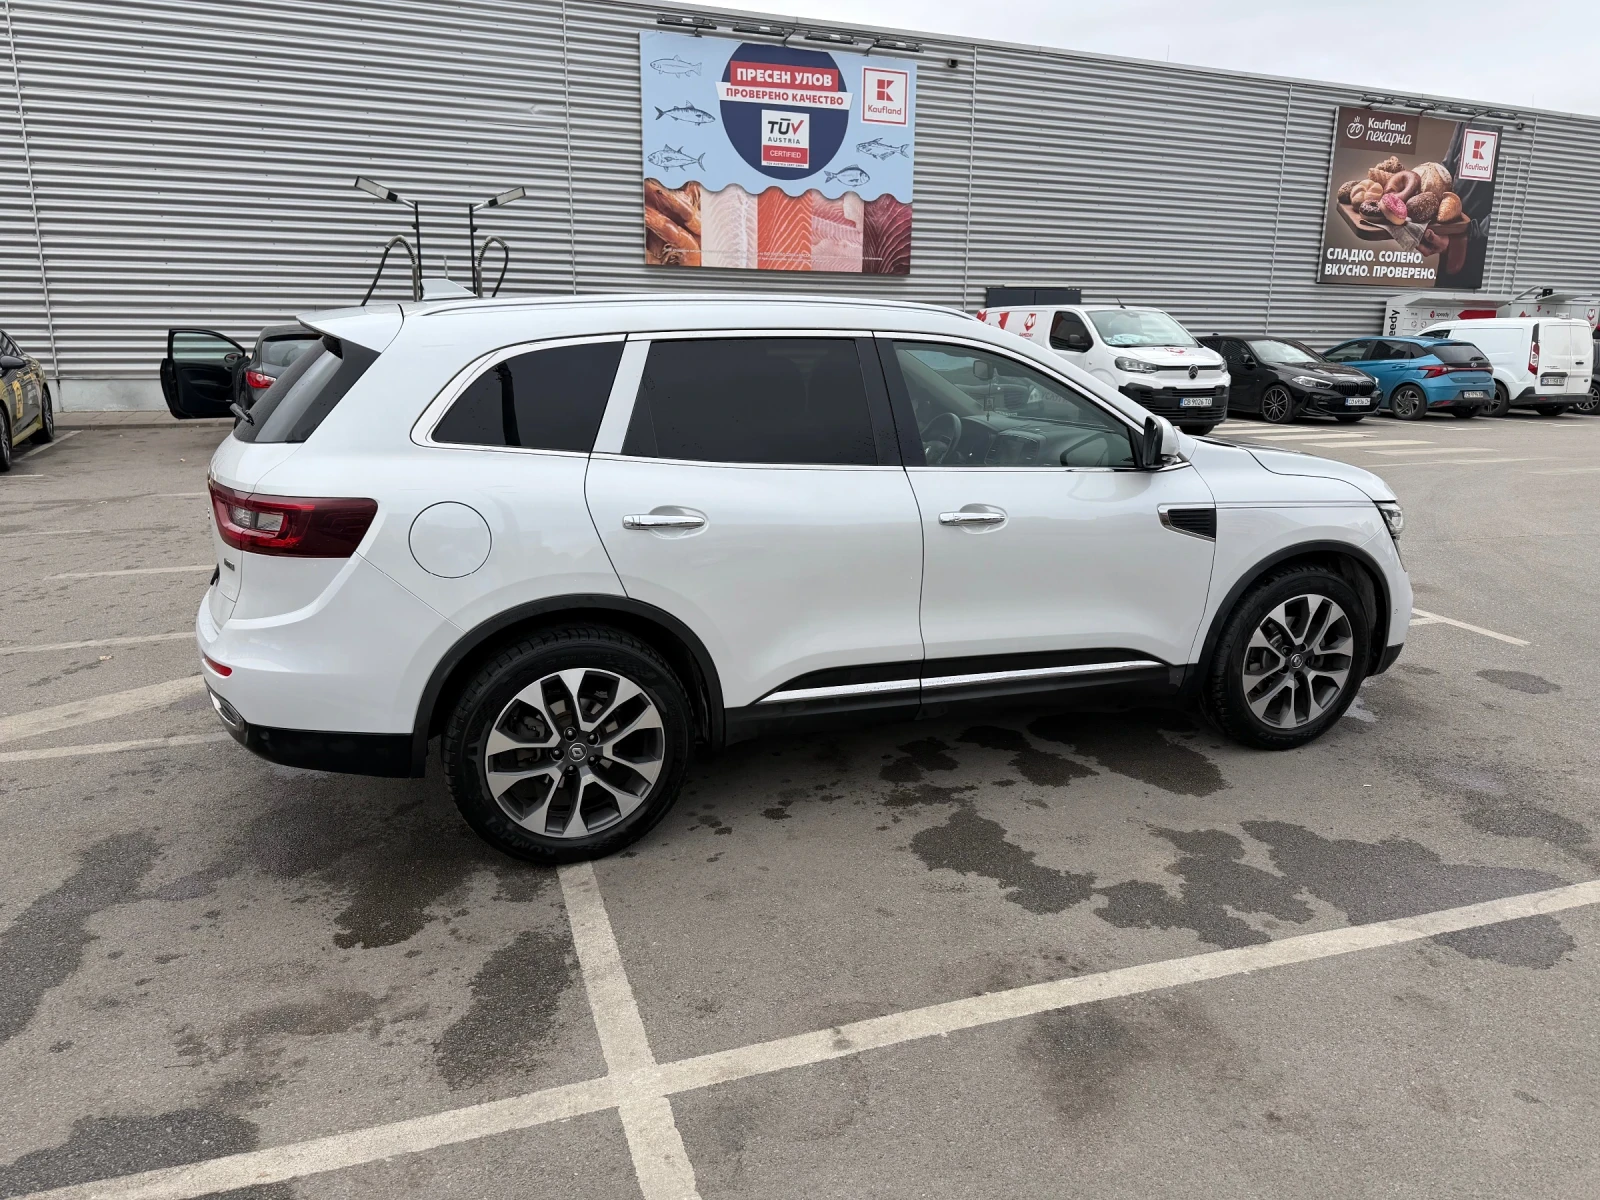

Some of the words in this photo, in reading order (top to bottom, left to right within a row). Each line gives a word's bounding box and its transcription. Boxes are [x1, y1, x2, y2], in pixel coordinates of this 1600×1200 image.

[737, 68, 790, 84] ПРЕСЕН
[795, 72, 832, 87] УЛОВ
[726, 88, 789, 101] ПРОВЕРЕНО
[792, 93, 844, 105] КАЧЕСТВО
[868, 104, 902, 115] Kaufland
[1368, 117, 1407, 132] Kaufland
[768, 136, 801, 144] AUSTRIA
[770, 150, 802, 158] CERTIFIED
[1464, 162, 1490, 172] Kaufland
[1326, 248, 1376, 263] СЛАДКО.
[1378, 250, 1424, 264] СОЛЕНО.
[1324, 263, 1370, 277] ВКУСНО.
[1372, 265, 1437, 280] ПРОВЕРЕНО.
[1388, 309, 1400, 336] eedy
